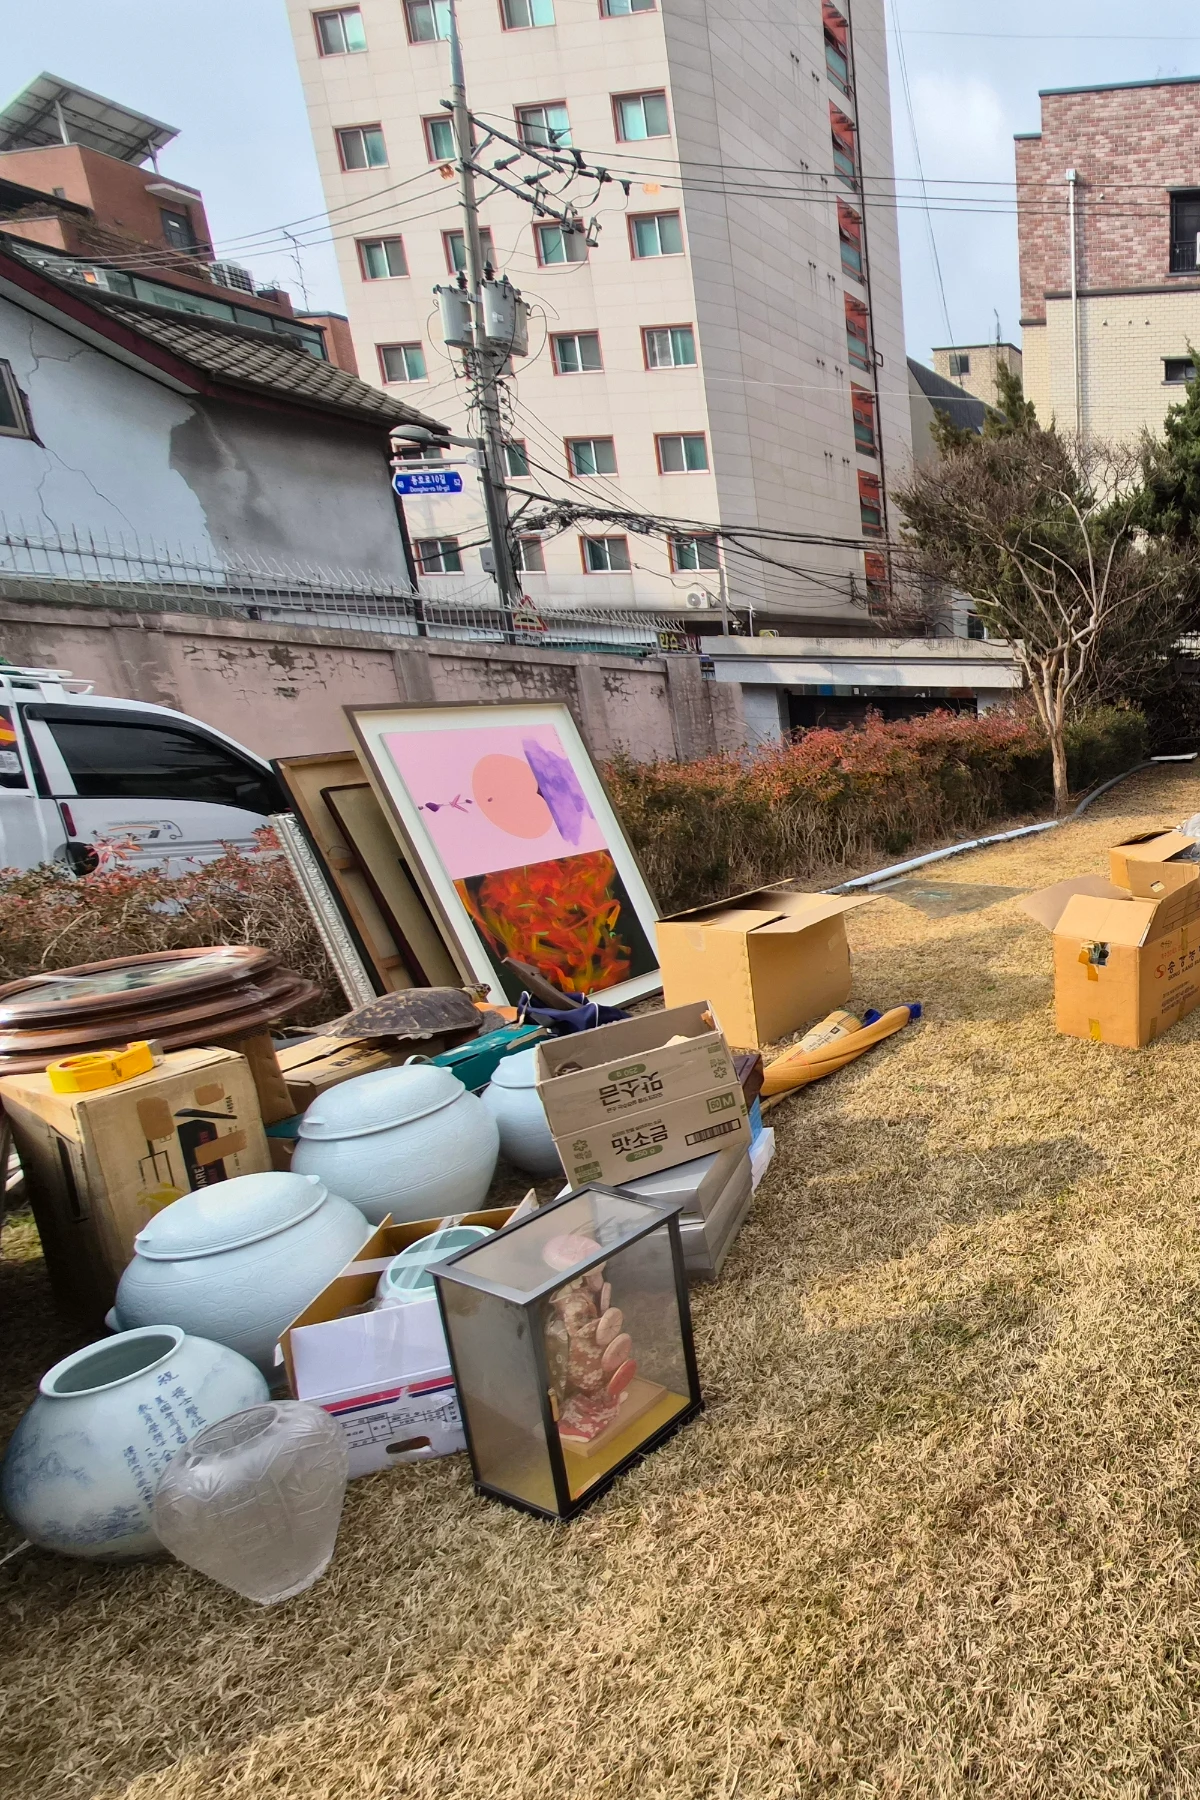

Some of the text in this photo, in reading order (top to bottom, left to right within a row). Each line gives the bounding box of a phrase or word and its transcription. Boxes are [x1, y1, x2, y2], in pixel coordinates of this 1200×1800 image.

[411, 474, 446, 485] 동호로10길
[599, 1071, 664, 1107] 맛소금
[611, 1124, 669, 1155] 맛소금
